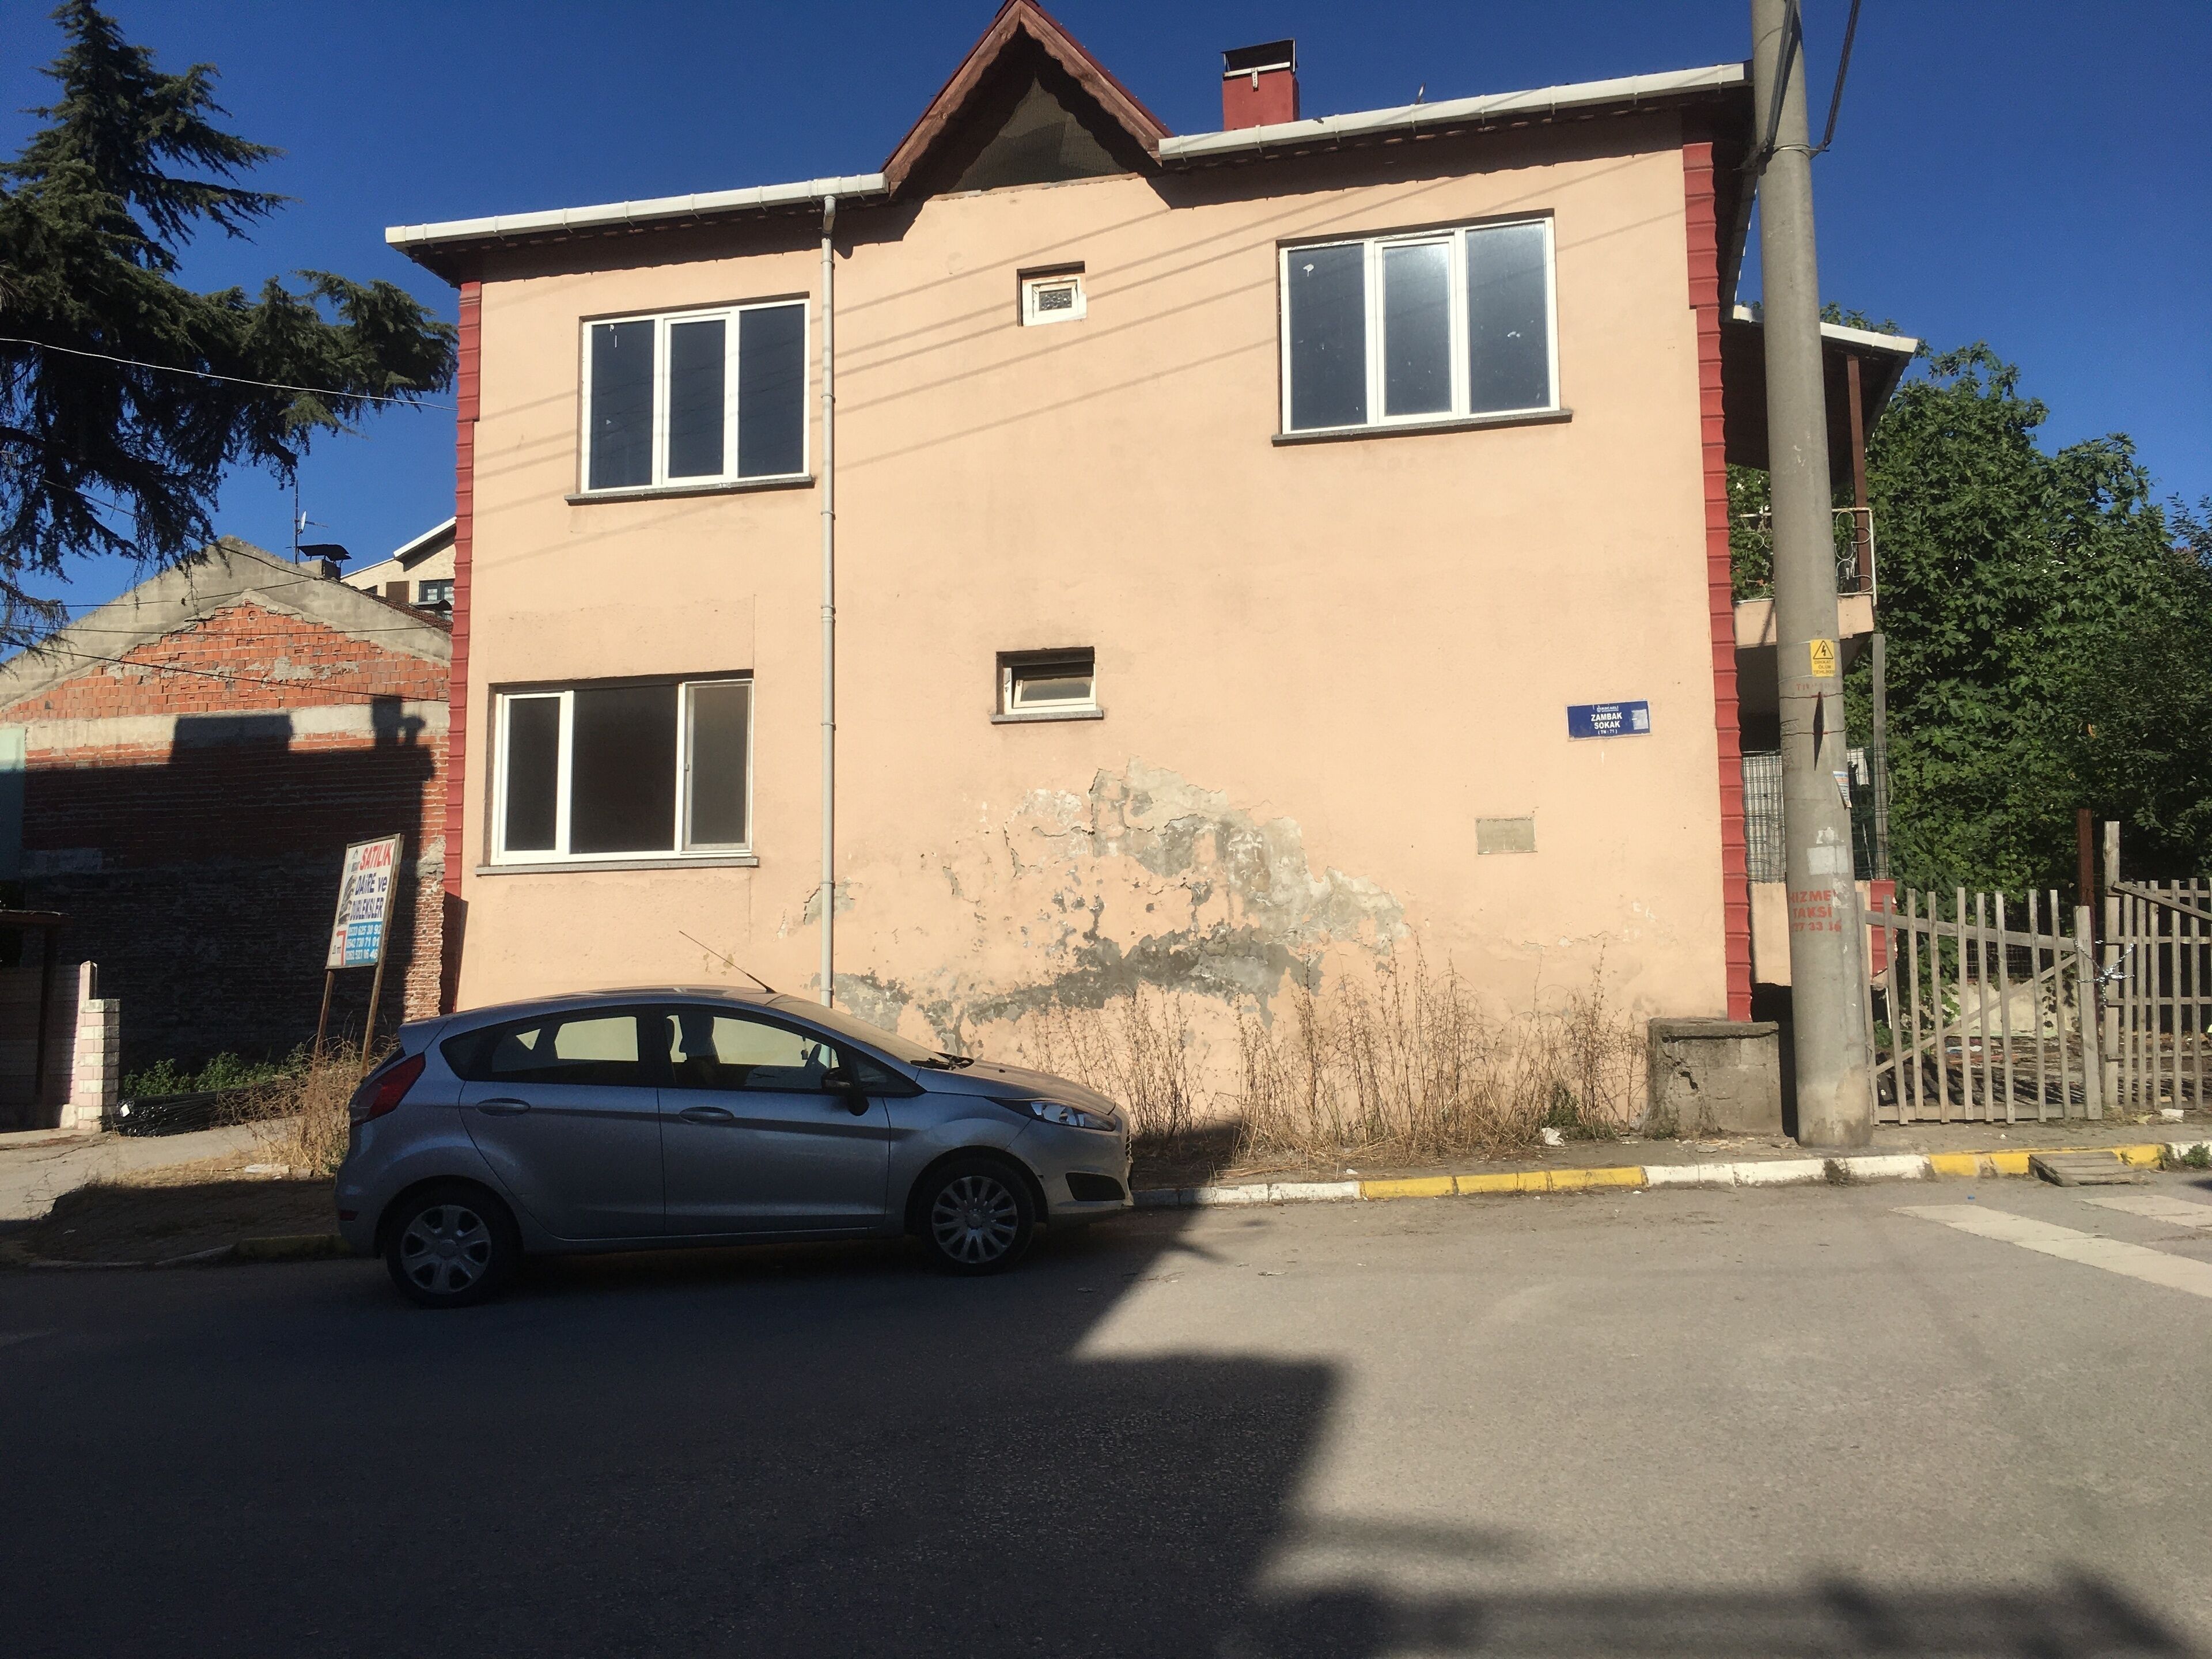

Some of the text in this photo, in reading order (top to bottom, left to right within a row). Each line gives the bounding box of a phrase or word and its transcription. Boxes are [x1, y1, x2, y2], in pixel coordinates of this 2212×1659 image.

[1590, 712, 1623, 721] ZAMBAK
[1594, 721, 1620, 729] SOKAK
[360, 842, 394, 870] SATILIK
[378, 876, 388, 892] ve
[374, 924, 382, 935] 92
[365, 936, 372, 947] 71
[372, 936, 380, 947] 01
